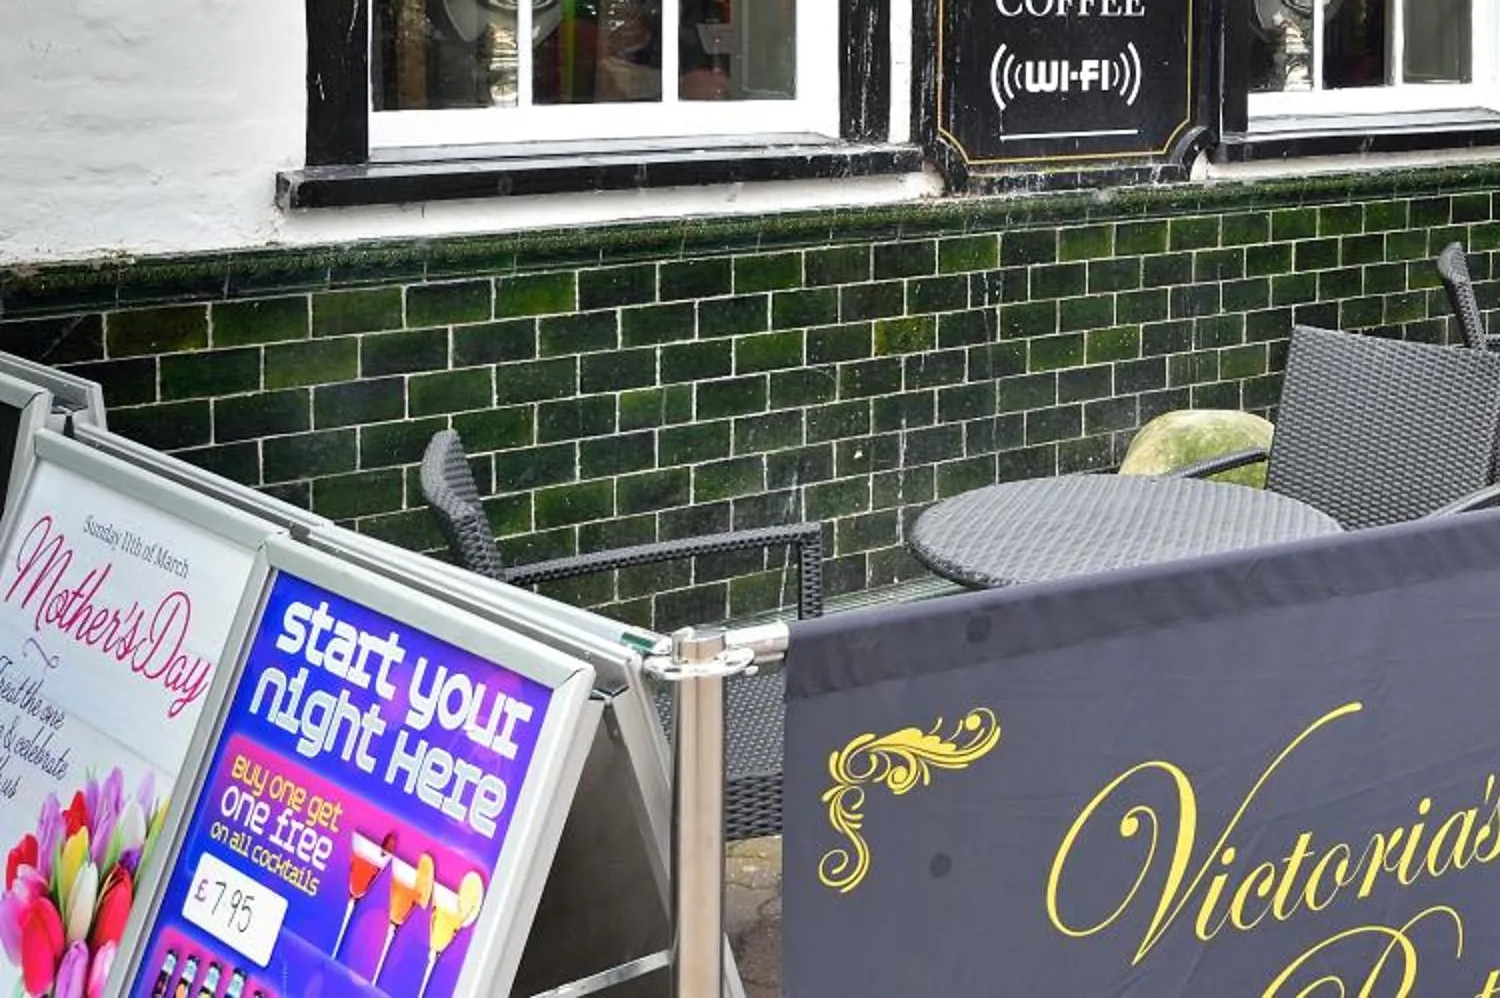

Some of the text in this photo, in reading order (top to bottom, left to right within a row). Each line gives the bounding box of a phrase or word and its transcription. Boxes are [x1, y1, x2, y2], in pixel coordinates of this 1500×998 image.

[83, 514, 190, 579] Sunday 11th of March
[5, 515, 212, 719] Mother's Day
[221, 785, 333, 872] one free
[269, 775, 307, 812] one
[306, 795, 343, 833] get
[210, 821, 321, 898] on all cocktails
